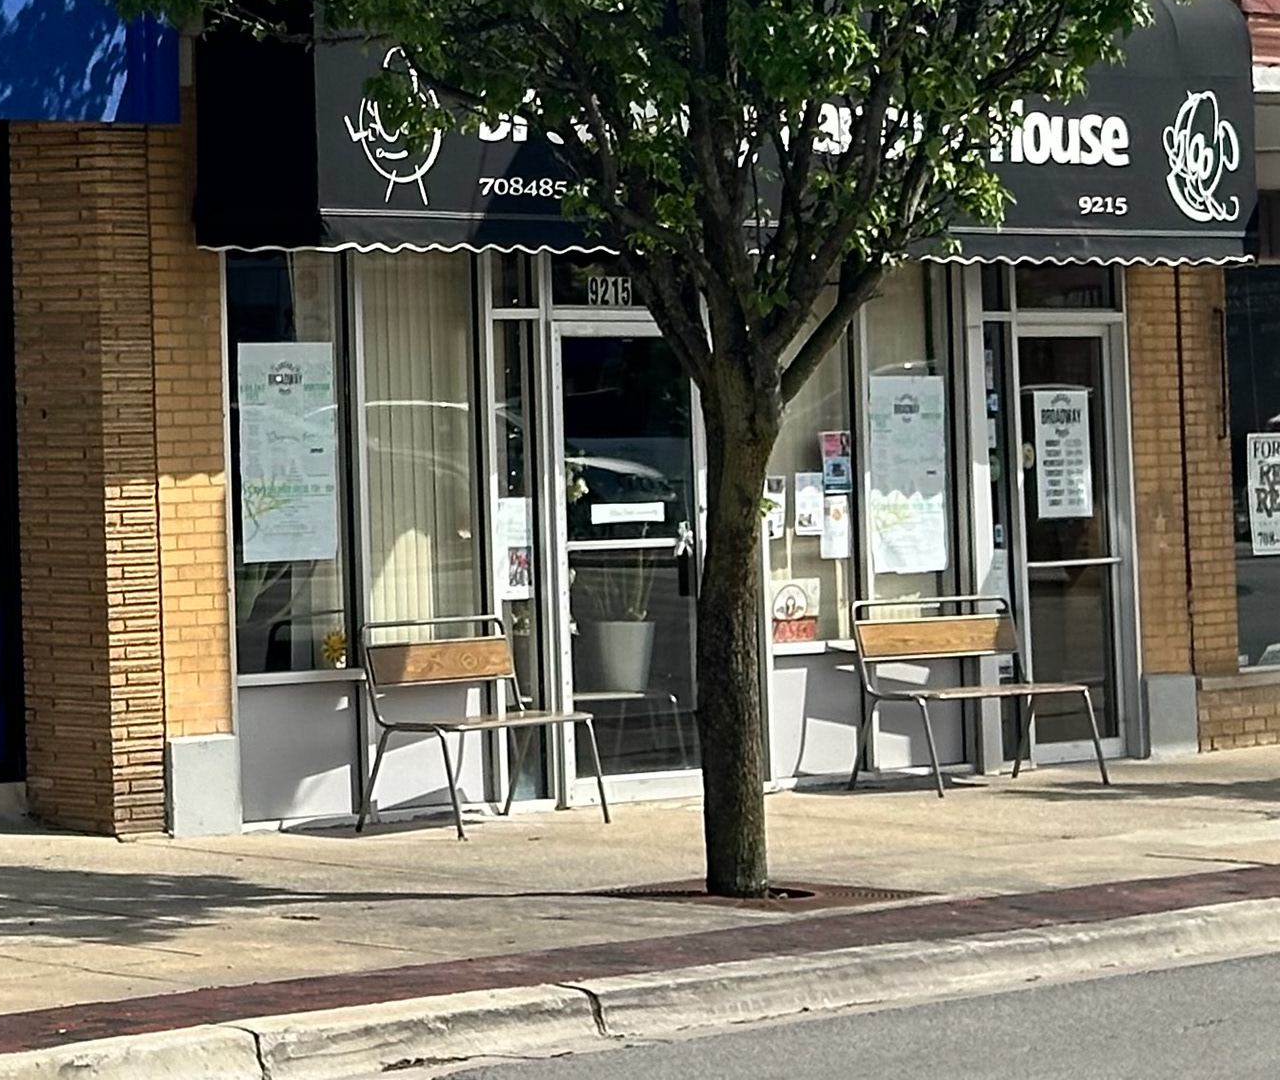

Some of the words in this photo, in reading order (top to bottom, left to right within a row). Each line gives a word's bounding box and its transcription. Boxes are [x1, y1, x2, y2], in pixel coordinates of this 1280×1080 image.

[478, 177, 590, 199] 708485
[1078, 196, 1129, 216] 9215
[589, 277, 631, 306] 9215
